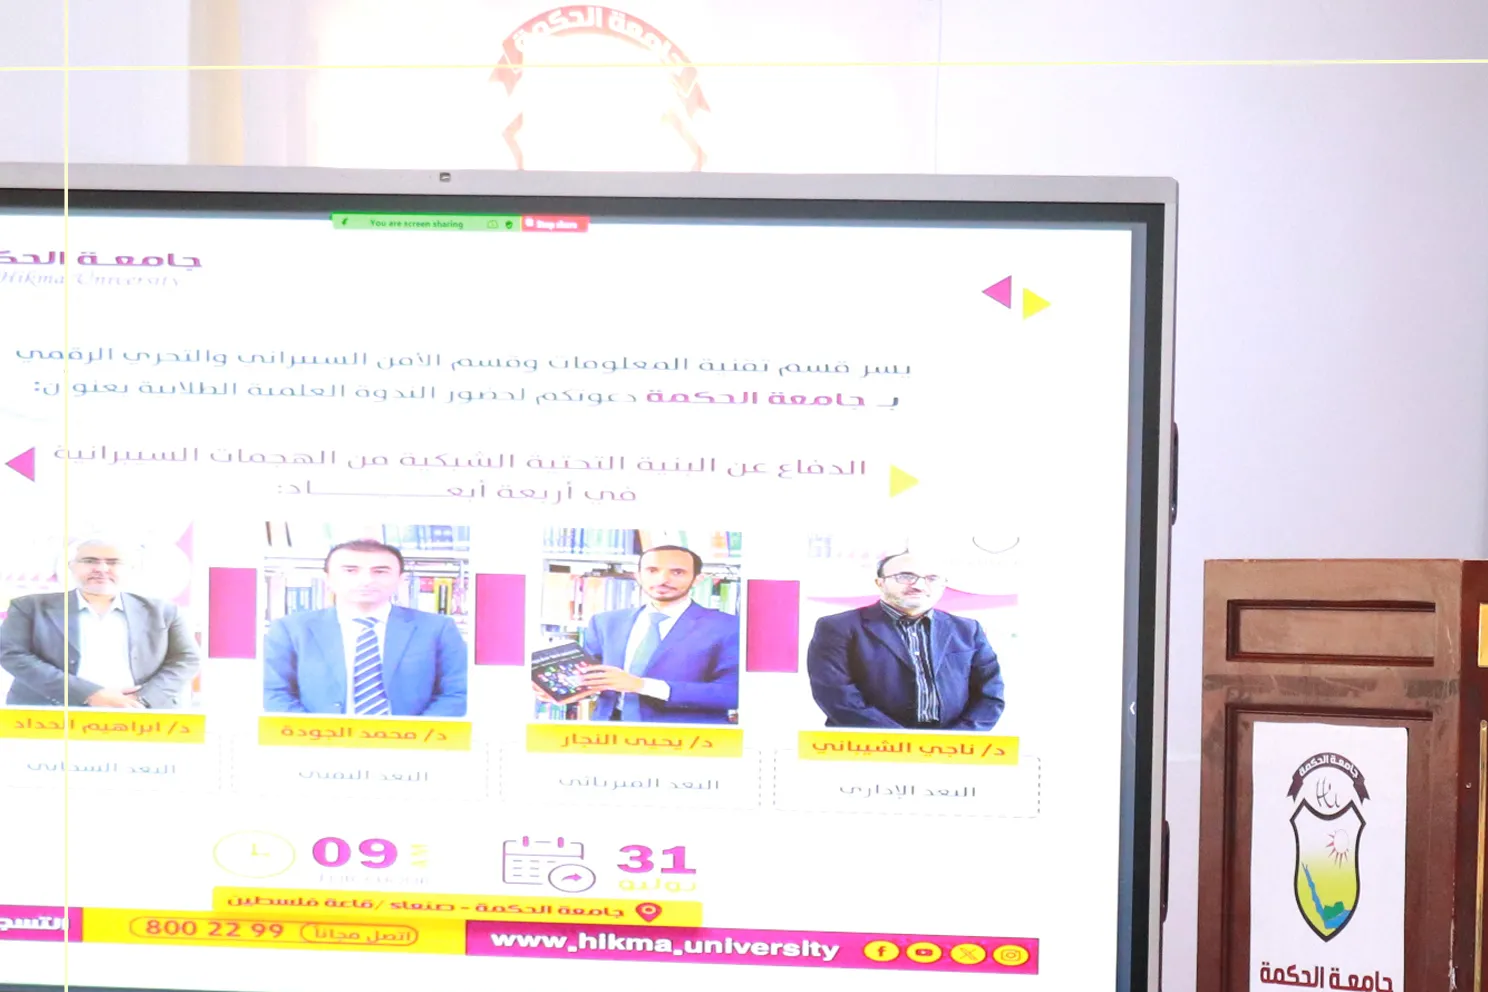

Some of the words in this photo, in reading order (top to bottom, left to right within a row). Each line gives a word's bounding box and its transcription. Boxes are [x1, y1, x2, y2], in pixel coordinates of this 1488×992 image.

[370, 219, 387, 229] You
[388, 221, 402, 230] are
[404, 221, 430, 230] screen
[432, 220, 464, 231] sharing
[0, 250, 65, 267] الحك
[78, 251, 202, 271] جامعة
[15, 346, 113, 364] الرقمي
[123, 348, 228, 367] والتحري
[376, 351, 441, 370] الأمن
[451, 354, 538, 373] وقسم
[548, 355, 688, 374] المعلومات
[699, 357, 769, 375] تقنية
[778, 359, 850, 376] قسم
[138, 380, 237, 397] الطلابية
[247, 382, 345, 399] العلمية
[355, 384, 435, 402] الندوة
[446, 386, 525, 404] لحضور
[535, 388, 637, 407] دعوتكم
[646, 389, 758, 405] الحكمة
[767, 391, 866, 410] جامعة
[54, 445, 198, 466] السيبرانية
[209, 448, 336, 469] الهجمات
[347, 454, 389, 469] من
[400, 450, 514, 472] الشبكية
[526, 453, 624, 473] التحتية
[636, 457, 715, 475] البنية
[726, 462, 767, 477] عن
[777, 459, 866, 478] الدفاع
[496, 481, 573, 504] أربعة
[584, 486, 636, 504] في
[280, 723, 354, 741] الجودة
[358, 726, 418, 744] محمد
[561, 732, 618, 751] النجار
[811, 737, 912, 757] الشيباني
[920, 740, 977, 758] ناجي
[312, 836, 398, 869] 09
[616, 844, 697, 875] 31
[227, 895, 319, 908] فلسطين
[475, 902, 552, 915] الحكمة
[557, 904, 625, 918] جامعة
[146, 919, 197, 936] 800
[208, 920, 241, 937] 22
[251, 923, 284, 938] 99
[366, 929, 411, 944] اتصل
[1260, 961, 1324, 989] الحكمة
